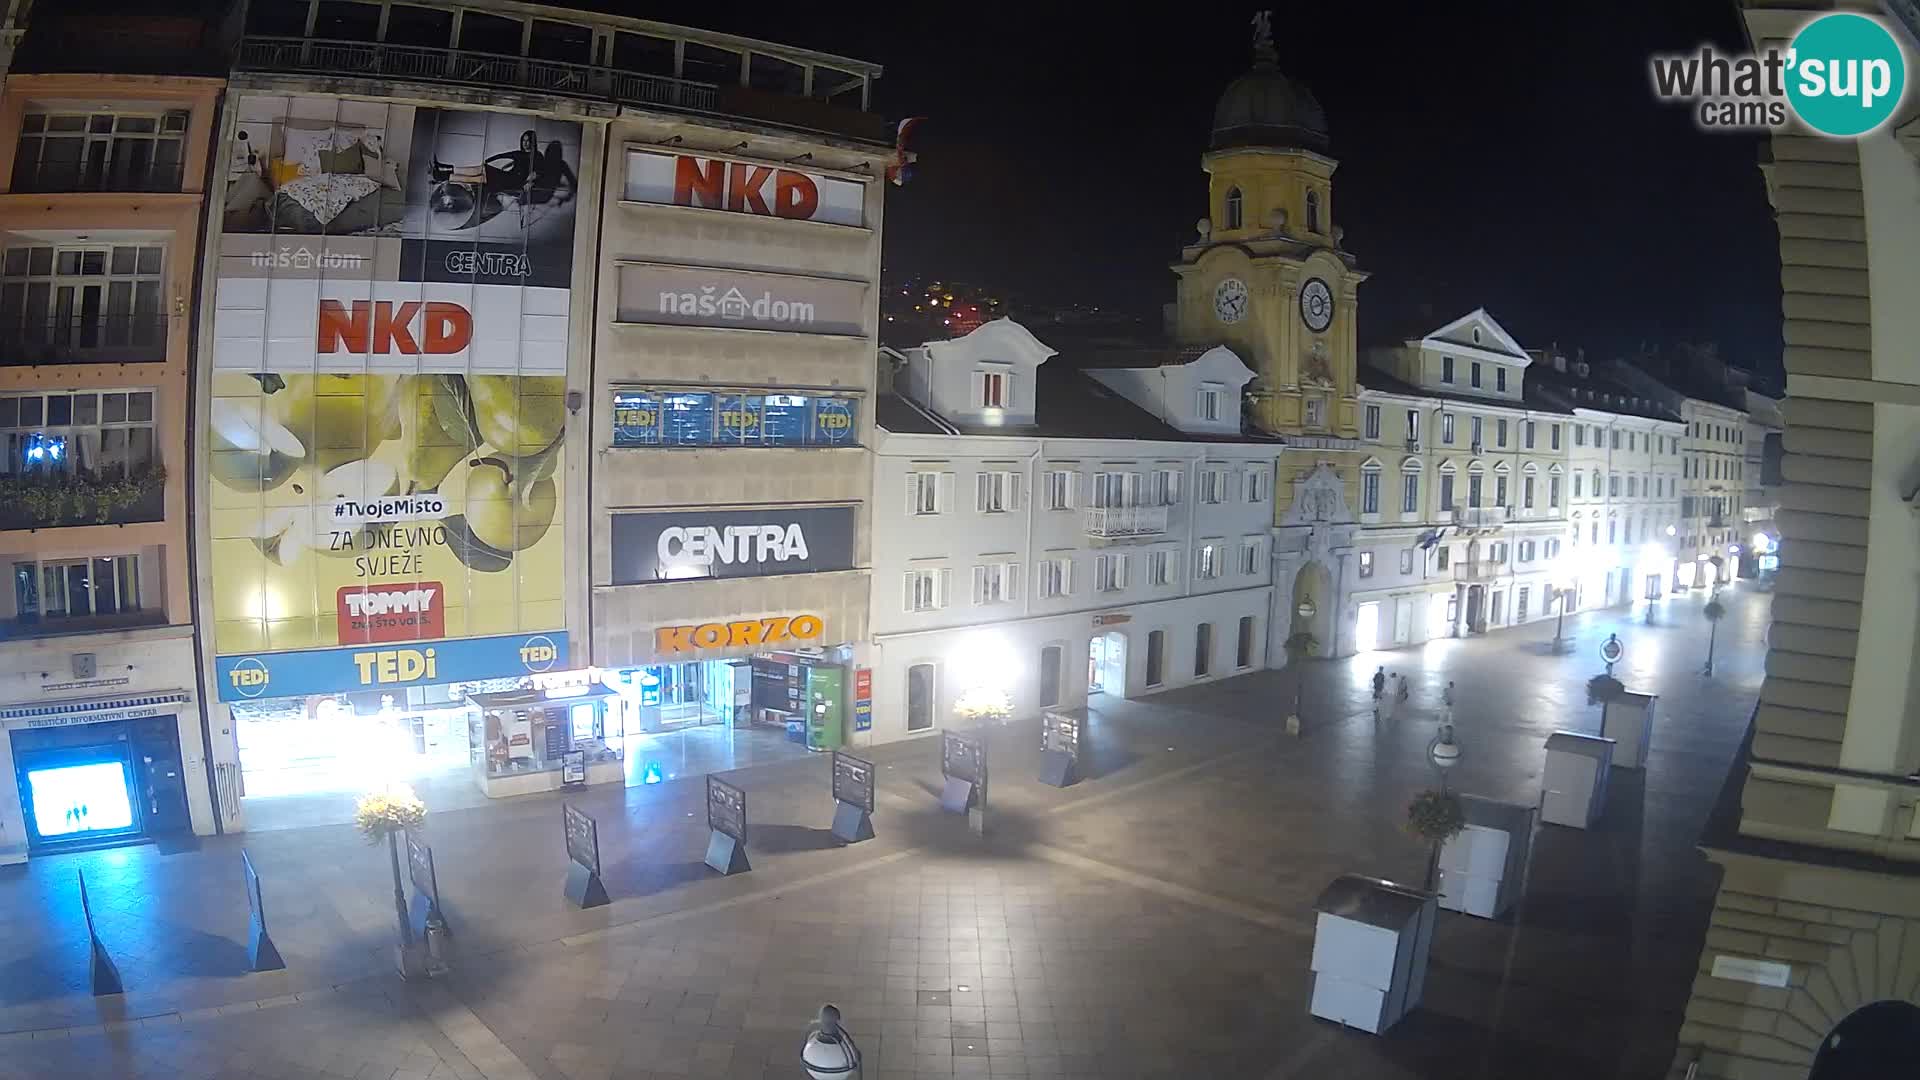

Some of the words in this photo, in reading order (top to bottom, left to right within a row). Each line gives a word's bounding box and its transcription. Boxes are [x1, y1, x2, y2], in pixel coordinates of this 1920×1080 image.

[672, 155, 820, 221] NKD
[251, 244, 291, 269] naš
[315, 247, 362, 270] dom
[444, 250, 532, 278] CENTRA
[658, 286, 717, 317] naš
[751, 290, 815, 323] dom
[317, 298, 474, 355] NKD
[615, 409, 657, 426] TEDi
[334, 497, 443, 519] #TvojeMisto
[329, 530, 354, 552] ZA
[364, 525, 448, 551] DNEVNO
[657, 522, 809, 565] CENTRA
[355, 549, 424, 578] SVJEŽE
[345, 589, 437, 617] TOMMY
[654, 614, 824, 655] KORZO
[354, 647, 438, 685] TEDi
[519, 644, 558, 665] TEDi
[229, 668, 270, 686] TEDi
